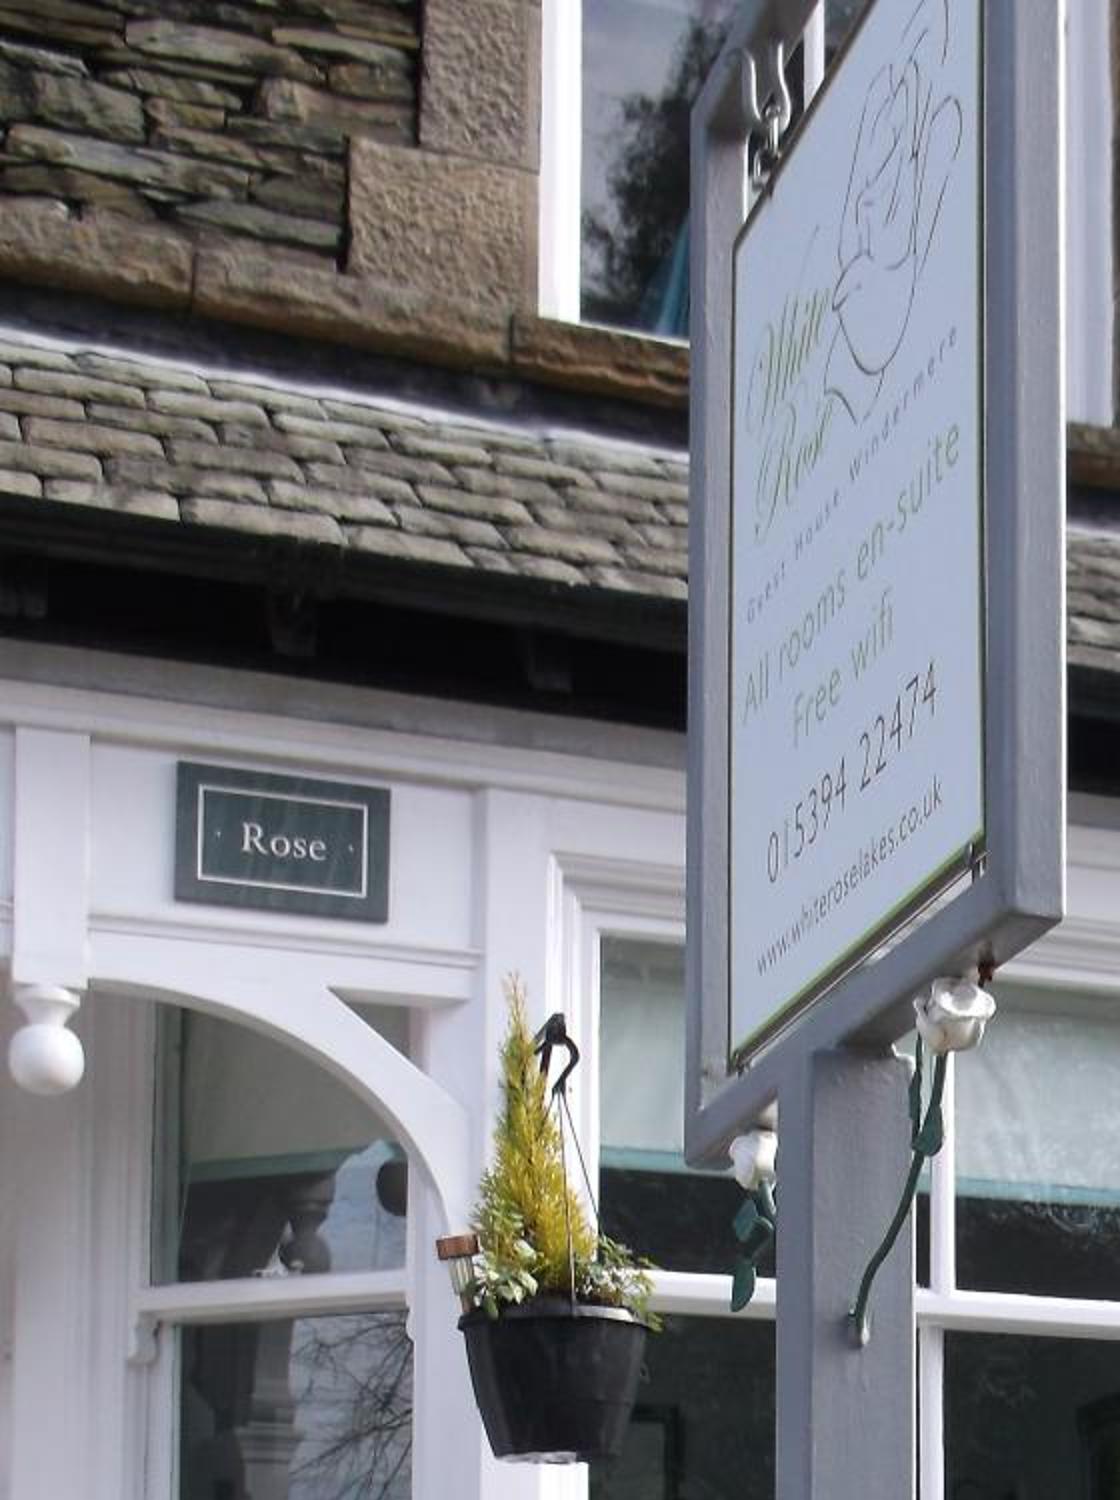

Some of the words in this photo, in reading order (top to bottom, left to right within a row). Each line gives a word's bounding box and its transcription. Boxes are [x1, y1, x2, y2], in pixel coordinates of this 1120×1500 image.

[742, 650, 769, 729] All
[779, 568, 846, 683] rooms
[856, 424, 959, 581] en-suite
[746, 561, 786, 624] Guest
[794, 487, 840, 560] House
[848, 326, 958, 482] Windermere
[766, 754, 847, 884] 015394
[858, 659, 937, 793] 22474
[793, 667, 842, 750] Free
[851, 585, 894, 681] wifi
[241, 821, 328, 862] Rose
[756, 772, 944, 977] www.whiteroselakes.co.uk
